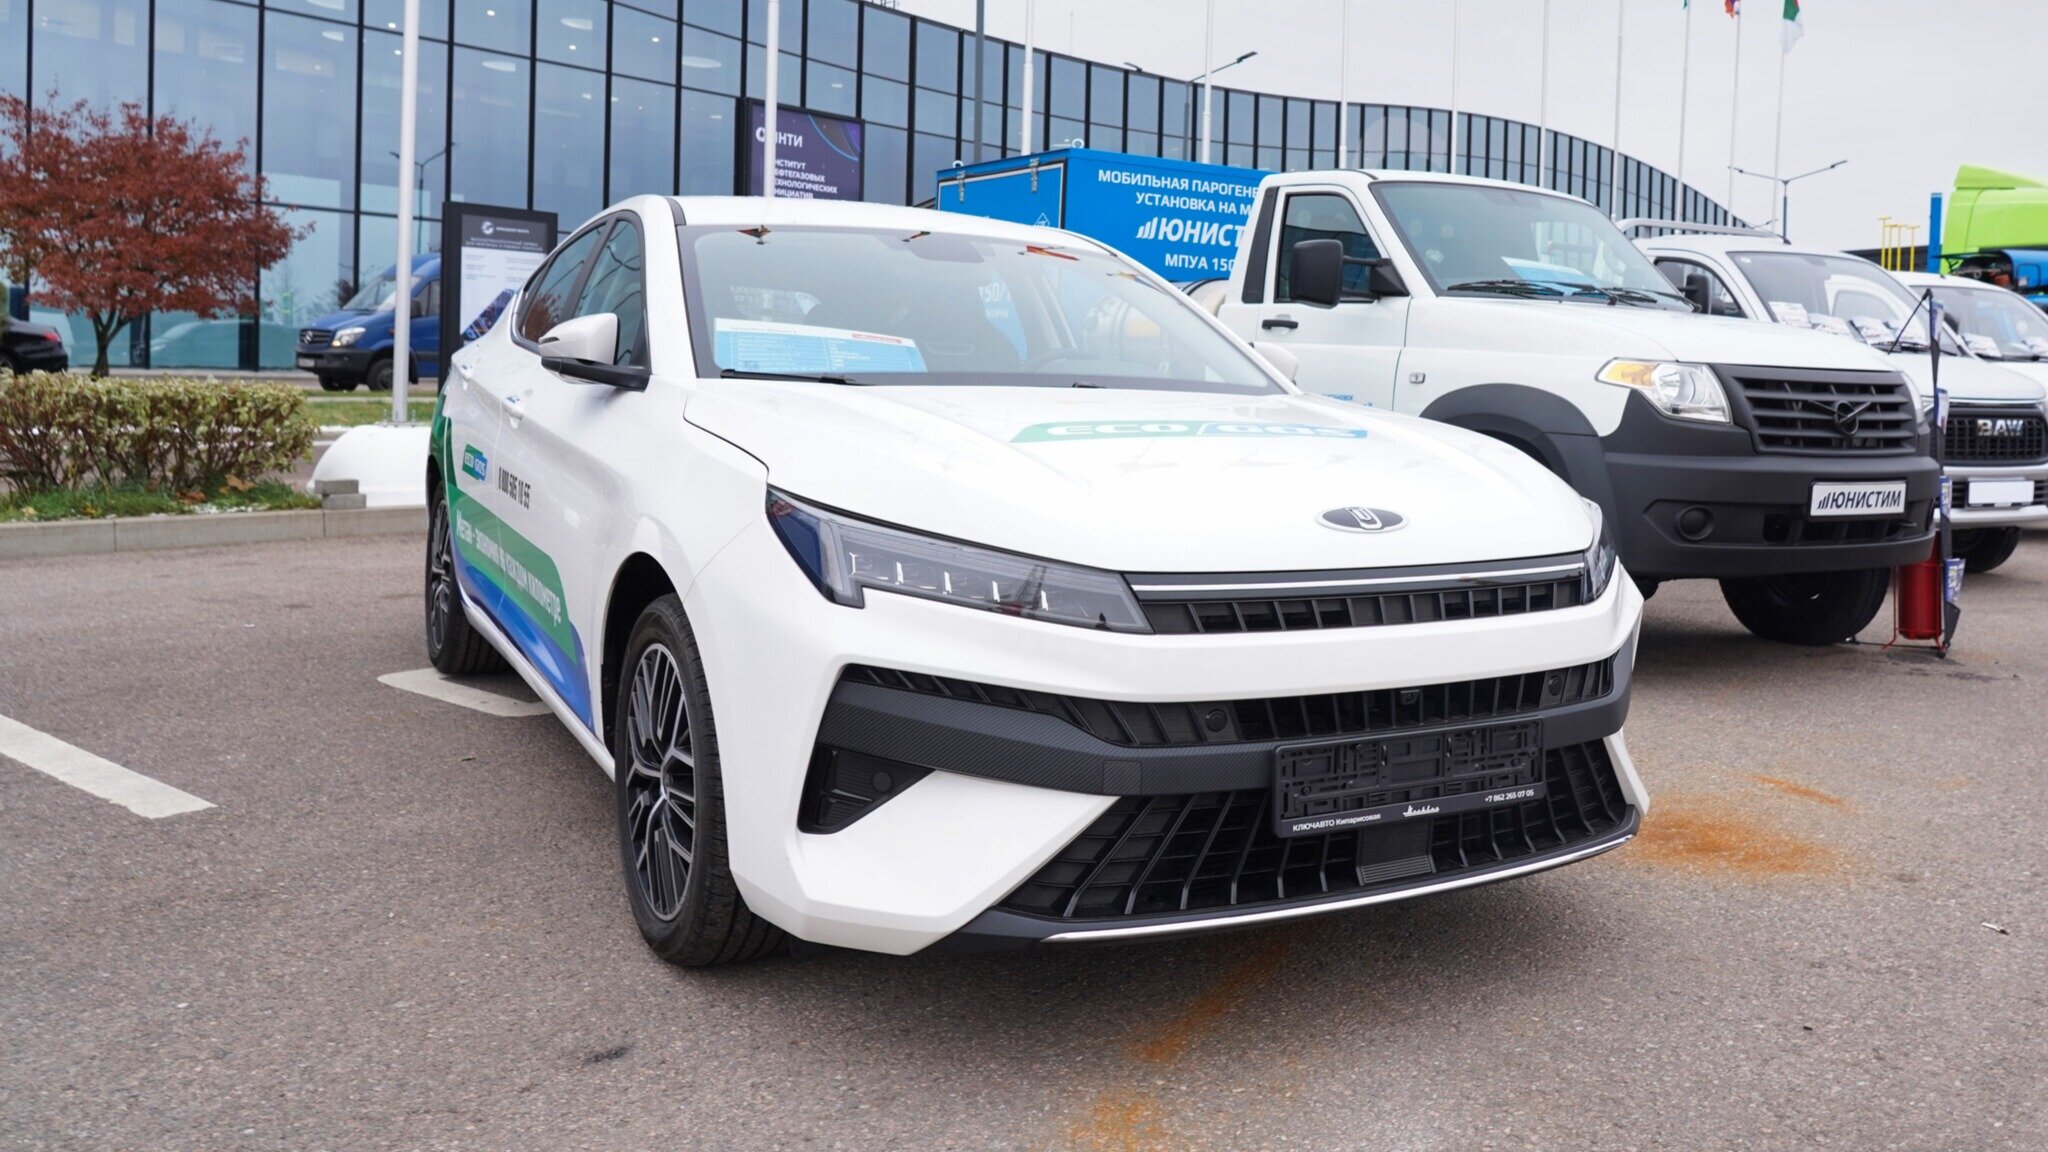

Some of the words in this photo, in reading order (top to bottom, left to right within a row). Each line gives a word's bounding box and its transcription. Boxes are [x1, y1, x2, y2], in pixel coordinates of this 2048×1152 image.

[775, 159, 805, 169] НСТИТУТ
[775, 169, 825, 182] ЕФТЕГАЗОВЫХ
[1098, 169, 1189, 190] МОБИЛЬНАЯ
[775, 178, 837, 193] ЕХНОЛОГИЧЕСКИХ
[775, 188, 813, 198] НИЦИАТИВ
[1135, 192, 1216, 212] УСТАНОВКА
[1218, 202, 1237, 214] НА
[1165, 253, 1208, 270] МПУА
[1977, 419, 2024, 436] BAW
[1830, 490, 1902, 509] ЮНИСТИМ
[1517, 790, 1525, 798] 07
[1292, 819, 1335, 832] КЛЮЧАВТО
[1336, 813, 1381, 827] Кипарисовая
